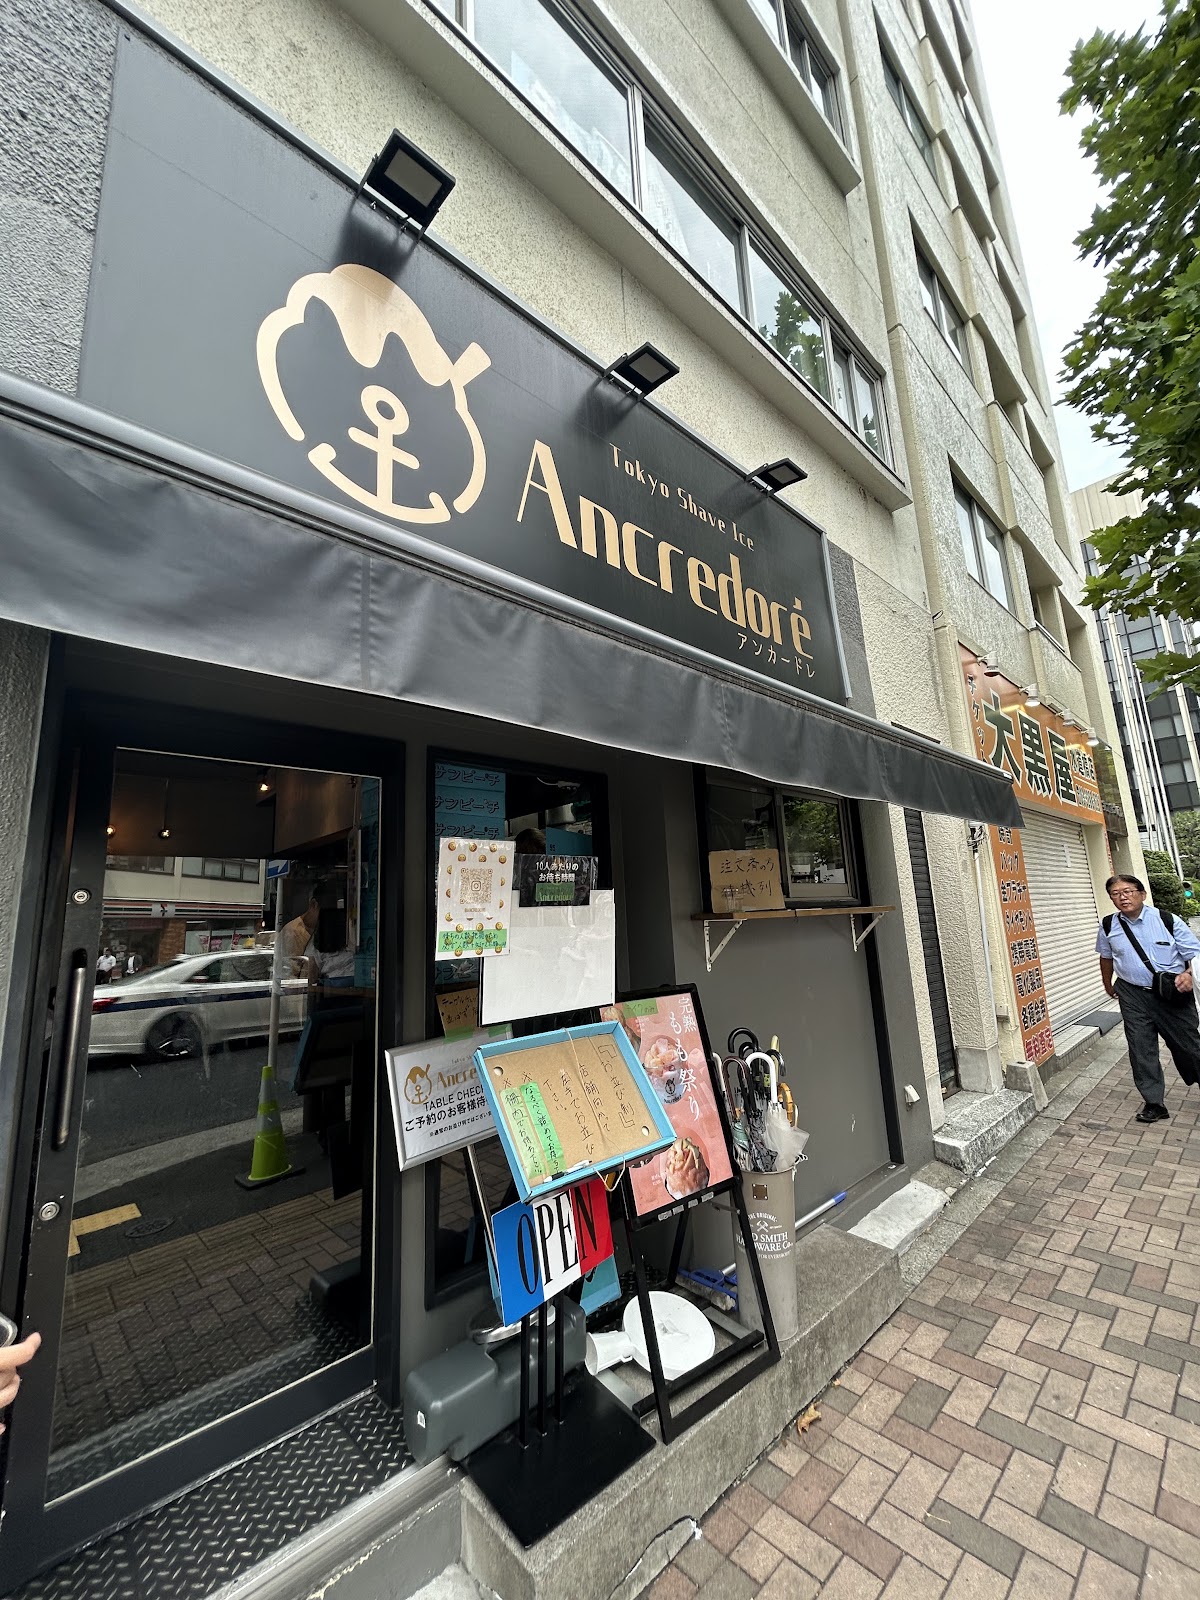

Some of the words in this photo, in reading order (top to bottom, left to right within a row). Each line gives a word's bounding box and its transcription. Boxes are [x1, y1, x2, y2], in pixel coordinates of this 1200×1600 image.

[609, 443, 669, 498] Tokyo
[677, 487, 726, 534] Shave
[732, 521, 754, 551] Ice
[516, 439, 814, 660] Ancredoré
[737, 632, 816, 679] アンカードレ
[981, 688, 1078, 806] 大黒屋
[535, 861, 579, 871] 10人あたりの
[538, 873, 575, 882] お待ち時間
[1010, 939, 1039, 967] 携帯電話
[1015, 968, 1043, 999] 電化製品
[678, 996, 697, 1033] 完熟
[669, 1011, 699, 1122] もも祭り
[405, 1096, 488, 1132] ご予約のお客様待
[424, 1093, 455, 1112] TABLE
[517, 1183, 598, 1295] OPEN
[760, 1231, 788, 1243] SMITH
